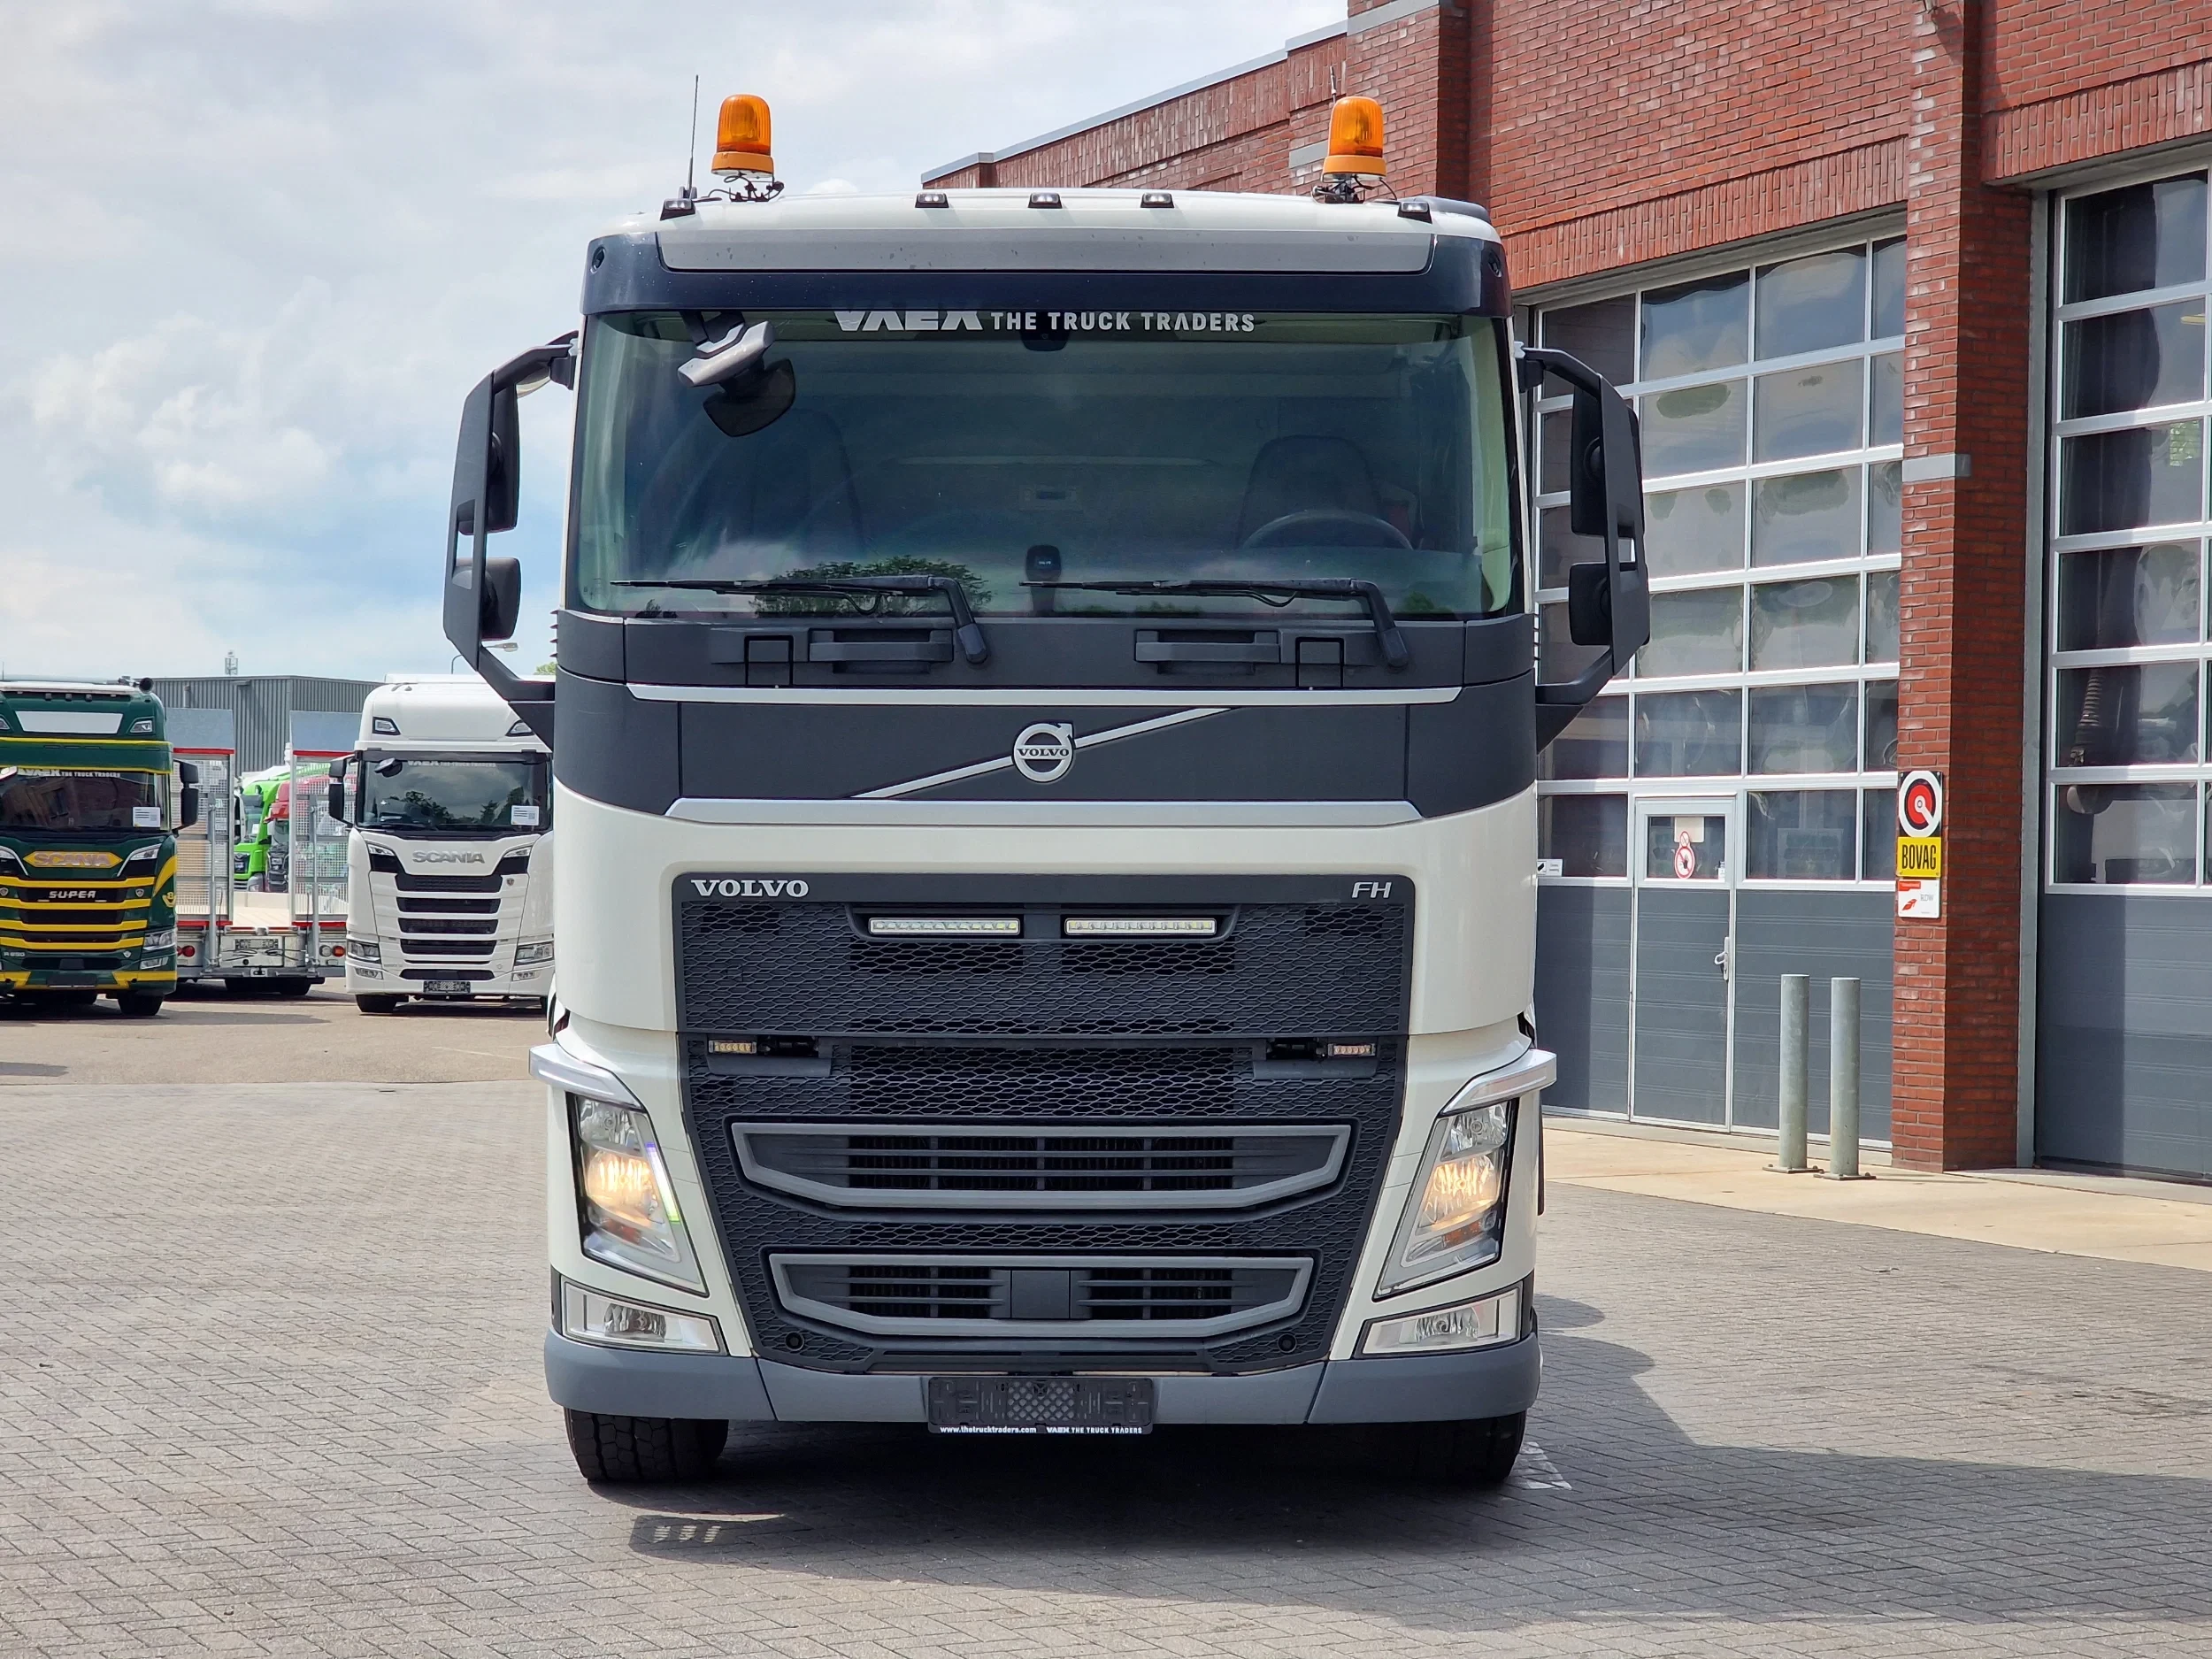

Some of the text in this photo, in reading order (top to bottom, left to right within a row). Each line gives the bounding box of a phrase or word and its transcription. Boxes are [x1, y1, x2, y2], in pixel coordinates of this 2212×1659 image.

[990, 311, 1037, 330] THE
[1048, 311, 1131, 331] TRUCK
[1141, 312, 1255, 332] TRADERS
[1017, 748, 1070, 757] VOLVO
[34, 852, 111, 866] SCANIA
[412, 850, 486, 864] SCANIA
[1901, 844, 1937, 870] BOVAG
[49, 890, 96, 899] SUPER
[690, 879, 809, 898] VOLVO
[1351, 881, 1392, 898] FH
